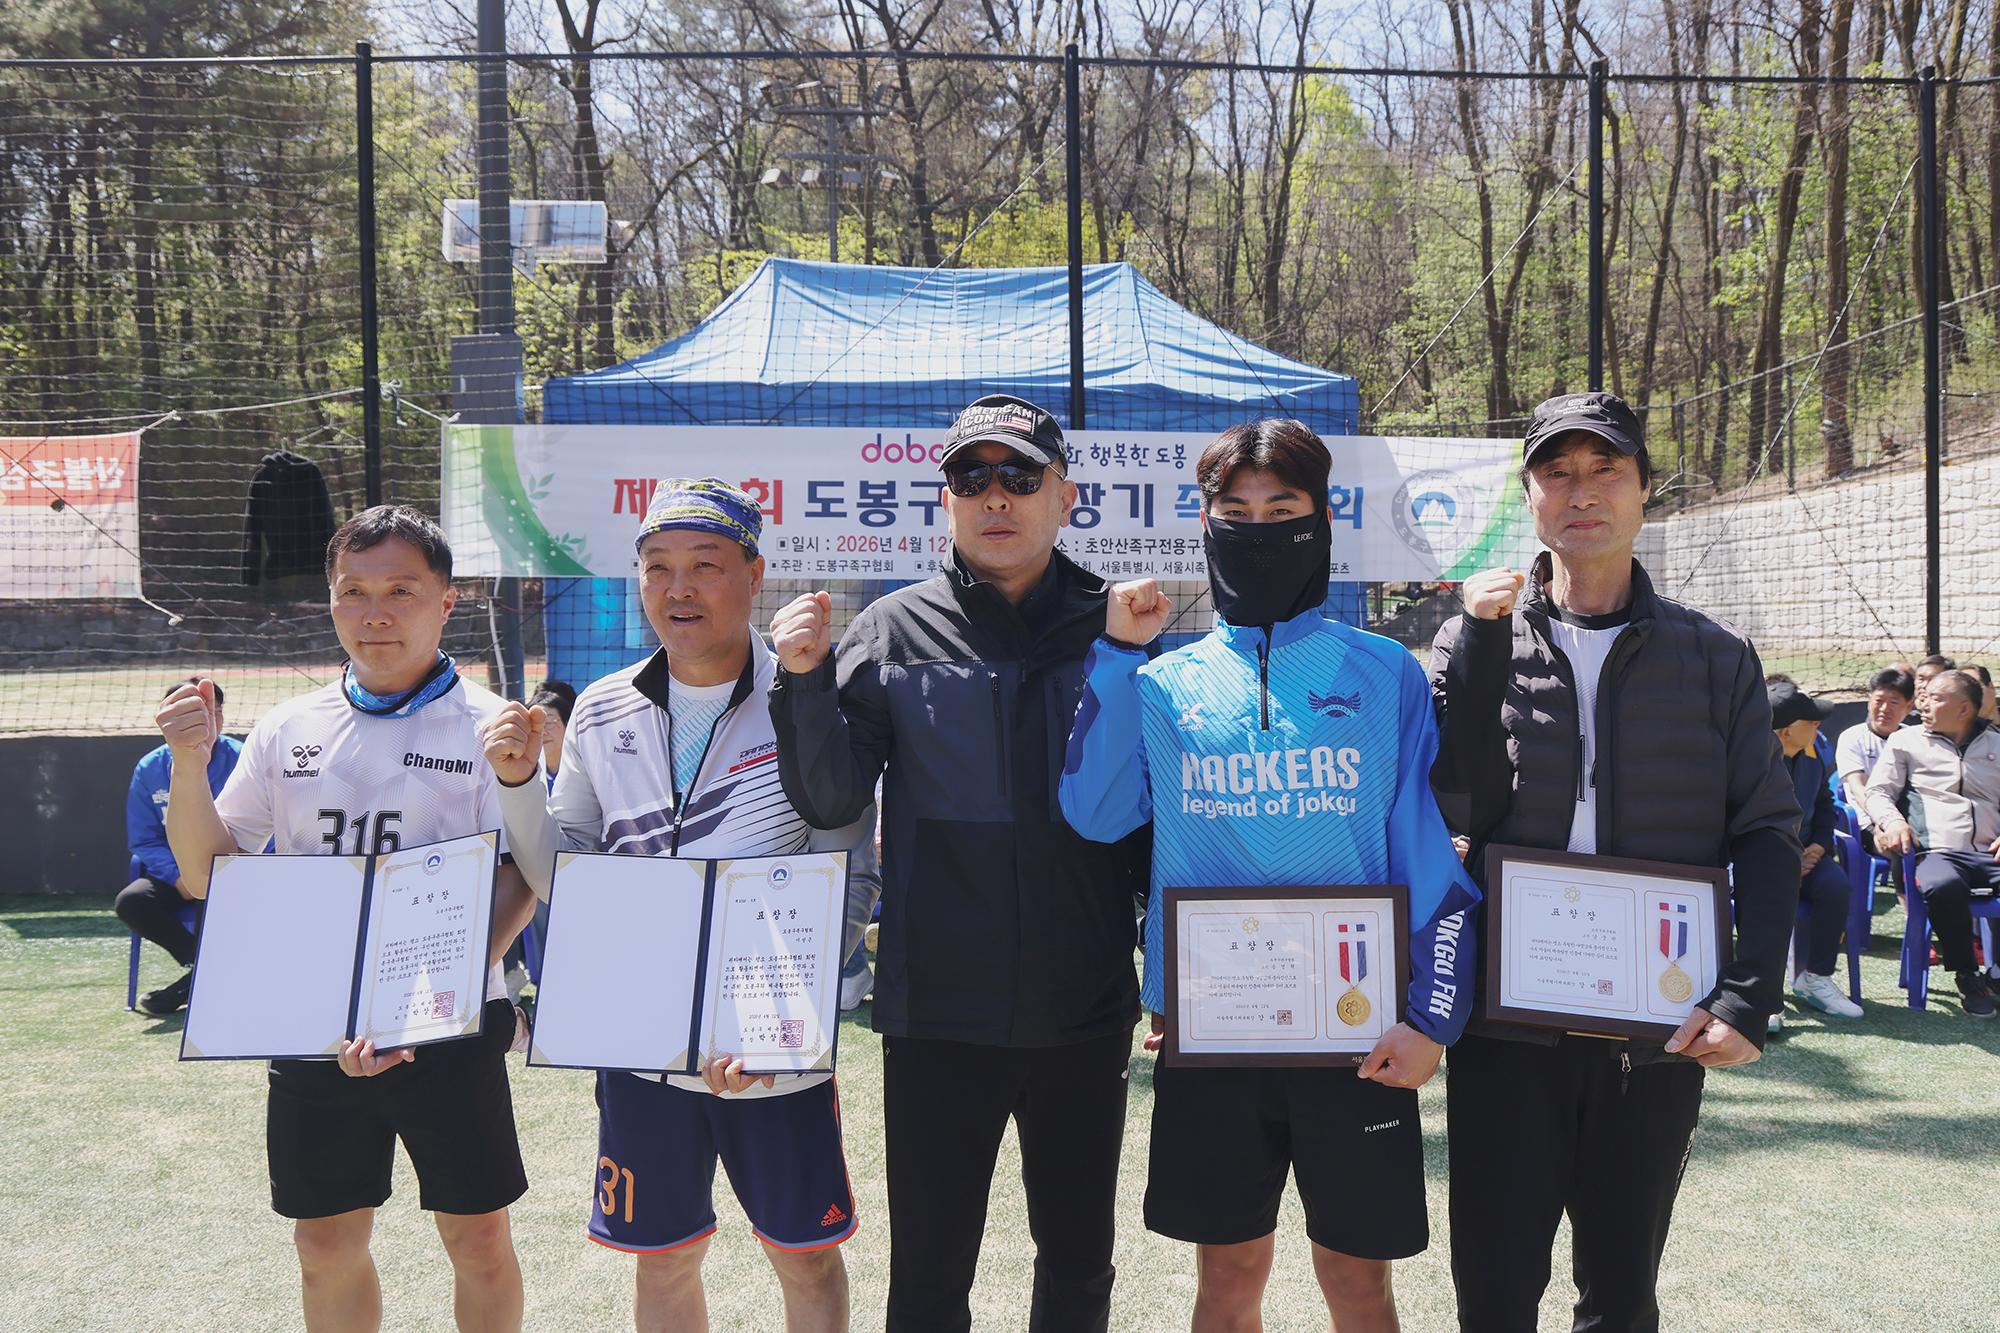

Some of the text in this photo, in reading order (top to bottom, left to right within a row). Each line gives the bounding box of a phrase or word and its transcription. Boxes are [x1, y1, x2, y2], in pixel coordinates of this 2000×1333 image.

[963, 403, 1033, 419] AMERICAN
[960, 414, 994, 429] ICON
[960, 423, 994, 437] VINTAGE
[861, 433, 944, 463] dobo
[1090, 443, 1149, 468] 행복한
[1156, 444, 1187, 469] 도봉
[792, 537, 819, 552] 일시
[837, 536, 892, 552] 2026년
[898, 536, 922, 553] 4월
[928, 537, 952, 552] 12
[1085, 538, 1205, 555] 초안산족구전용구
[780, 560, 802, 572] 주관
[816, 560, 894, 573] 도봉구족구협회
[1100, 560, 1158, 574] 서울특별시,
[1163, 560, 1208, 574] 서울시족
[613, 746, 637, 755] hummel
[403, 752, 473, 776] ChangMI
[1182, 746, 1361, 794] HACKERS
[283, 768, 320, 778] hummel
[1182, 790, 1356, 820] legend of jokgu
[1432, 911, 1465, 976] OKGU
[1351, 1056, 1367, 1064] 서울
[1364, 1119, 1400, 1133] PLAYMAKER
[599, 1156, 635, 1223] 31
[820, 1212, 847, 1227] adidas
